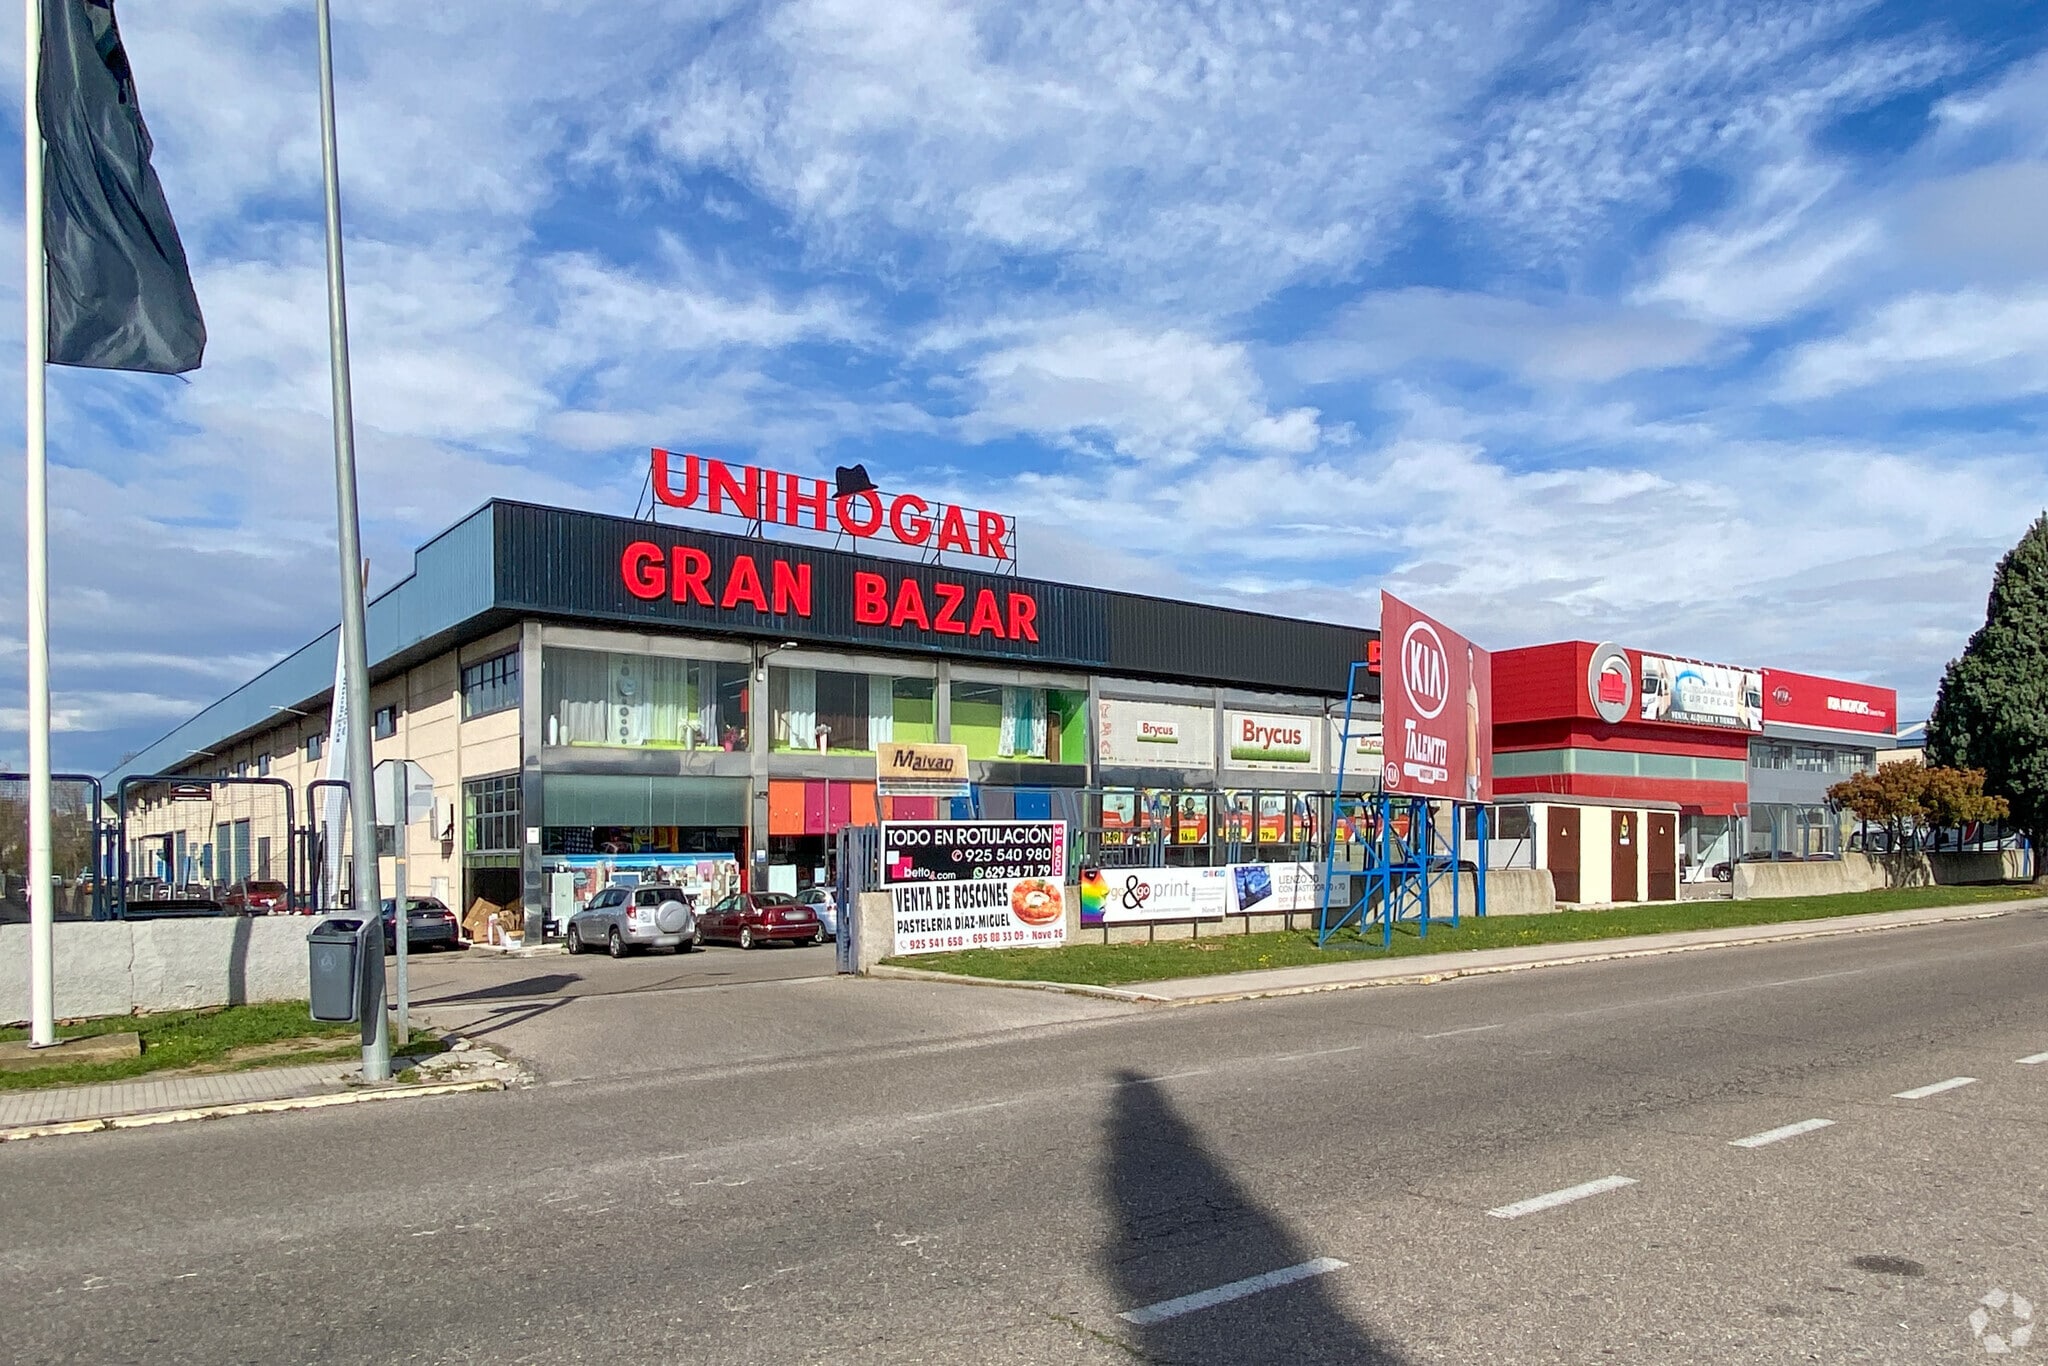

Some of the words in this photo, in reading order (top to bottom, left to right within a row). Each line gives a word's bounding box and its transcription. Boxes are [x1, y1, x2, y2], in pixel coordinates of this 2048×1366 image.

[653, 448, 1008, 559] UNIHOGAR
[621, 541, 811, 618] GRAN
[855, 571, 1040, 643] BAZAR
[1410, 639, 1442, 700] KIA
[1682, 693, 1735, 707] EUROPEAS
[1142, 722, 1174, 738] Brycus
[1243, 719, 1302, 749] Brycus
[1405, 718, 1447, 766] TALENTO
[893, 750, 954, 772] Maivan
[887, 829, 931, 846] TODO
[935, 828, 953, 845] EN
[956, 824, 1052, 845] ROTULACIÓN
[965, 849, 993, 862] 925
[996, 849, 1022, 861] 540
[1026, 848, 1051, 861] 980
[1054, 845, 1062, 875] nave
[985, 866, 1003, 879] 629
[1007, 866, 1020, 878] 54
[1023, 865, 1034, 877] 71
[1038, 865, 1051, 877] 79
[895, 887, 933, 912] VENTA
[937, 885, 950, 910] DE
[954, 883, 1008, 909] ROSCONES
[1154, 878, 1189, 901] print
[1295, 883, 1325, 892] ASTIDOR
[955, 912, 1010, 931] DÍAZ-MIGUEL
[909, 939, 926, 949] 925
[929, 938, 944, 948] 541
[947, 936, 963, 947] 658
[973, 933, 987, 943] 695
[990, 932, 1000, 942] 88
[1002, 931, 1012, 941] 33
[1014, 930, 1024, 939] 09
[1031, 931, 1052, 940] Nave
[1054, 929, 1063, 938] 26
